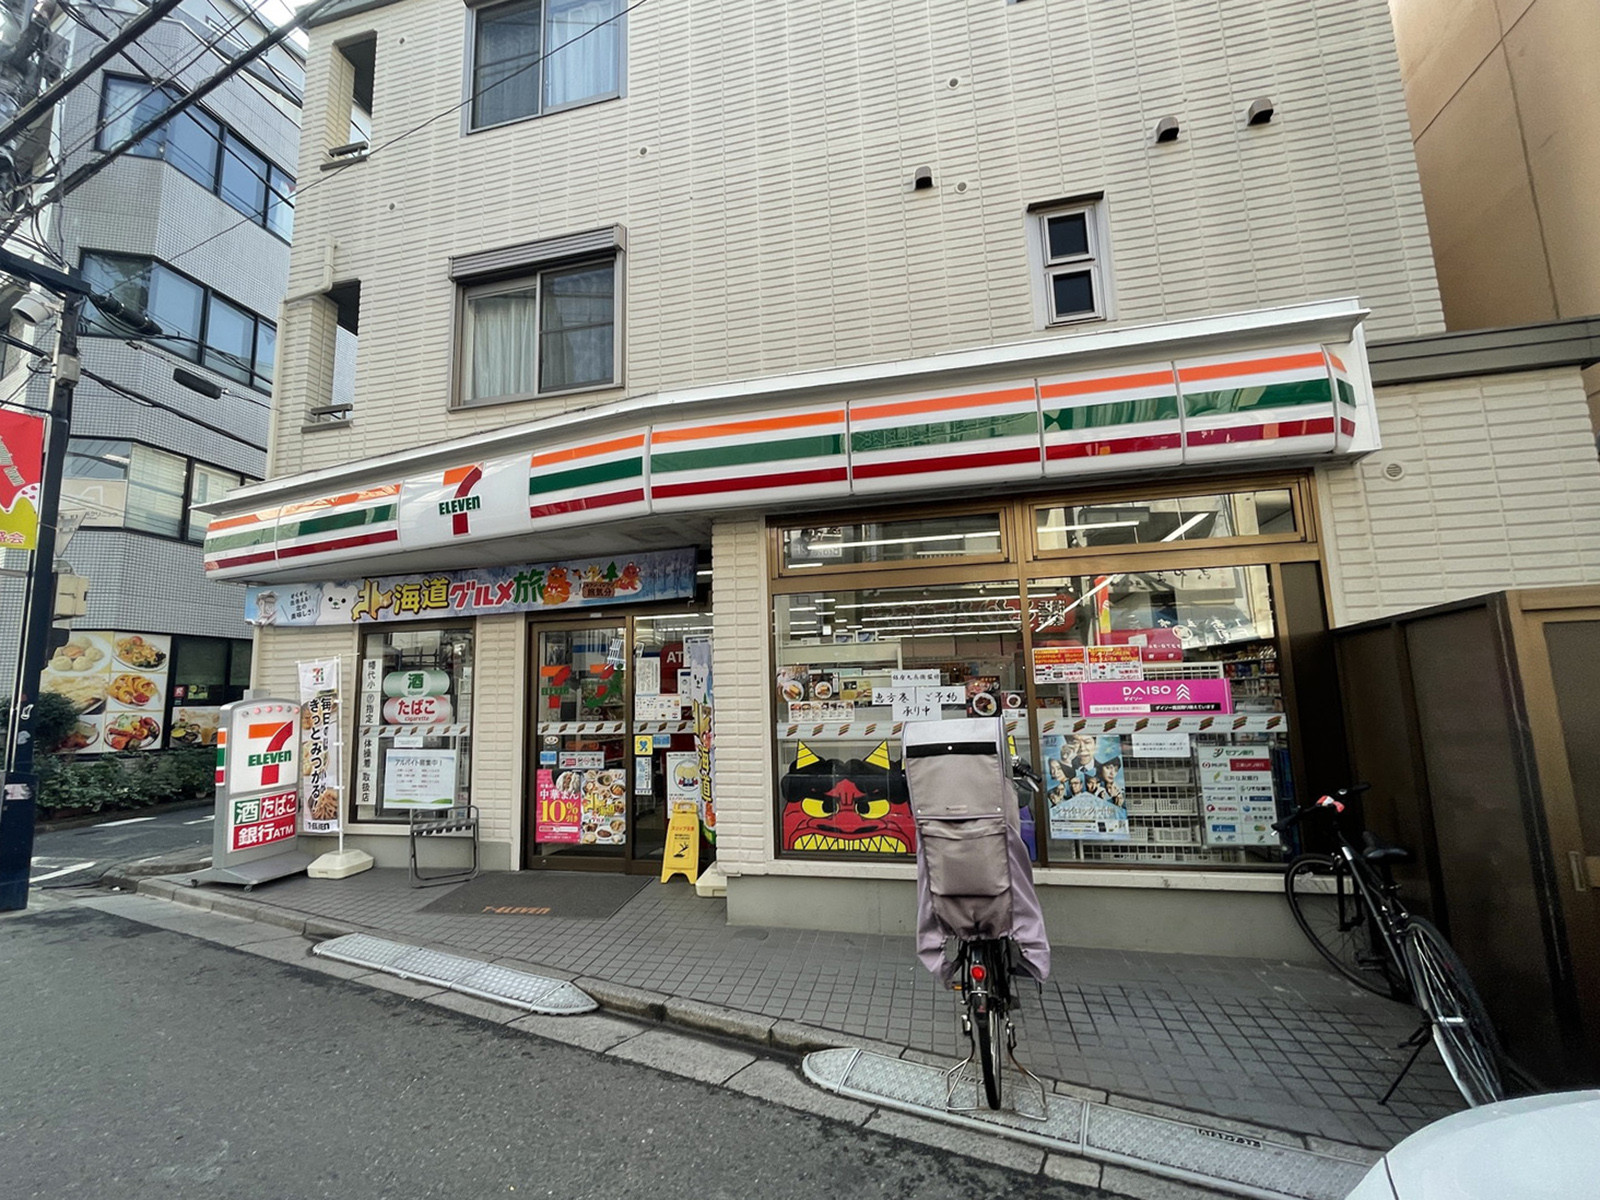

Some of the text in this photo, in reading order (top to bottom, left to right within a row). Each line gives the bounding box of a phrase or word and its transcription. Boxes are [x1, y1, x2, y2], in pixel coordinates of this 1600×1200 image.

[666, 651, 684, 664] AT
[407, 673, 424, 689] 酒
[873, 692, 911, 704] 恵方巻
[924, 691, 958, 704] ご予約
[1122, 685, 1172, 697] DAISO
[398, 699, 436, 715] たばこ
[902, 705, 931, 717] 承り中
[247, 720, 294, 786] 7
[540, 788, 580, 800] 中華まん
[236, 802, 260, 824] 酒
[261, 794, 296, 819] たばこ
[238, 823, 294, 847] 銀行ATM
